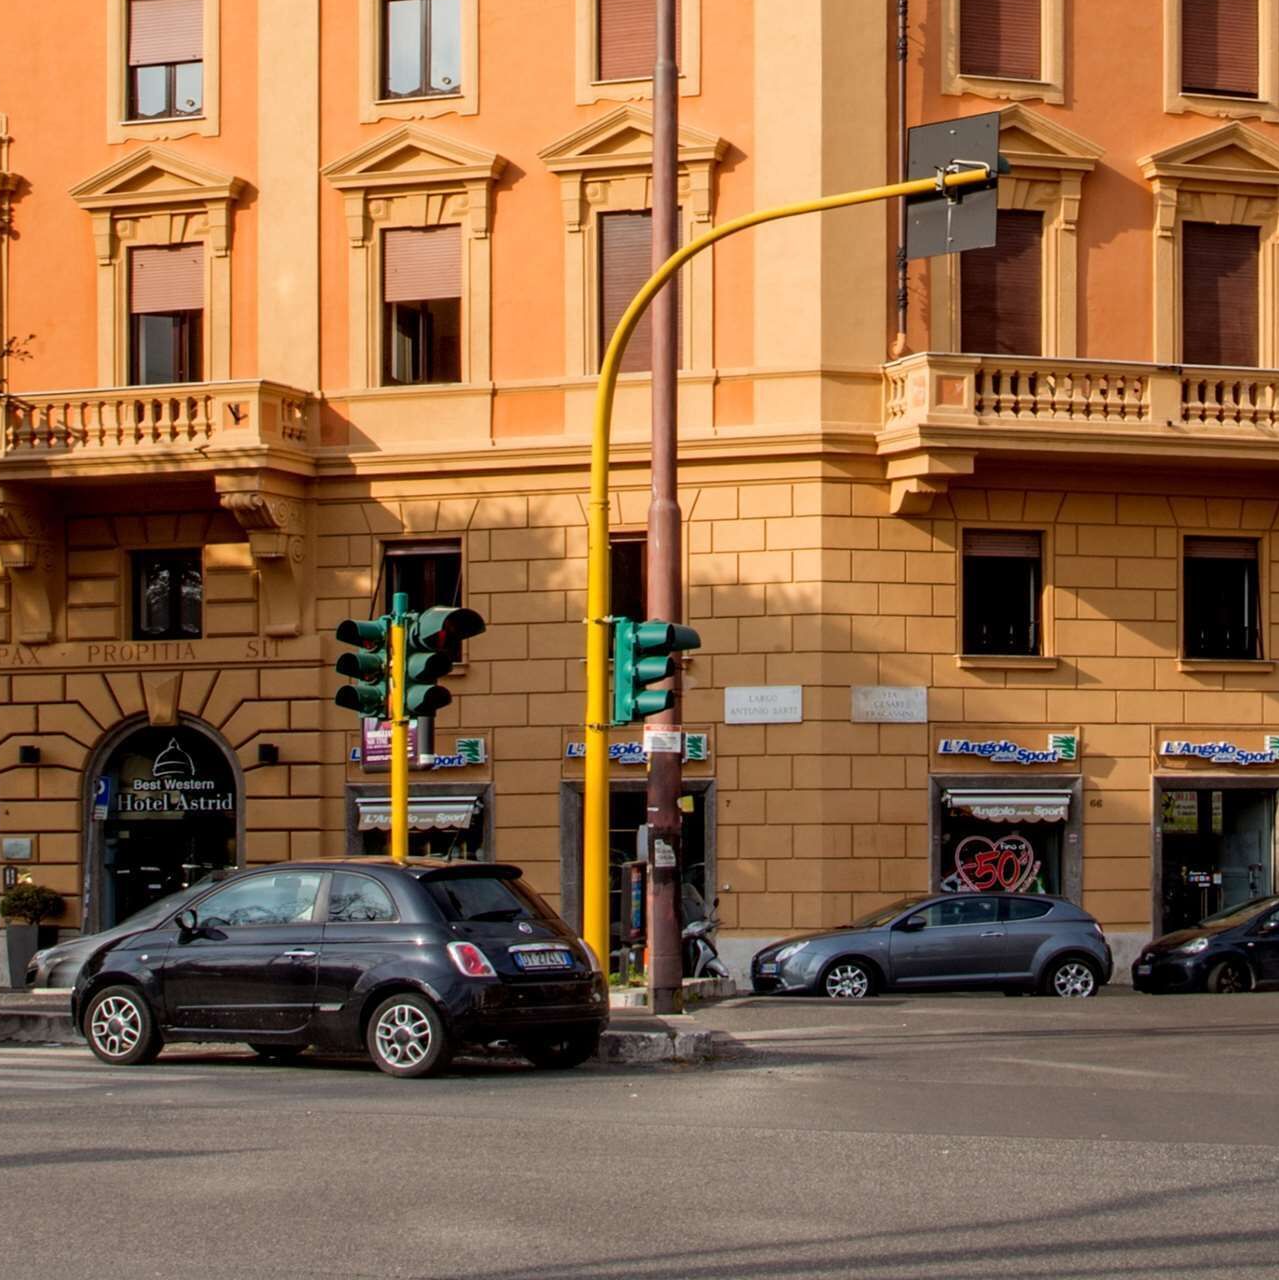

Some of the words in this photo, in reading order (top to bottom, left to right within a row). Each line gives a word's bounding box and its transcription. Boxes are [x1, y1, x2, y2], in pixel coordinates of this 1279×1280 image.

[87, 642, 196, 662] PROPITIA
[245, 640, 284, 658] SIT
[941, 740, 1017, 755] L'Angolo
[1017, 749, 1058, 763] Sport
[1164, 742, 1236, 756] L'Angolo
[1236, 750, 1274, 763] Sport
[432, 753, 465, 768] port
[133, 778, 161, 790] Best
[164, 778, 215, 790] Western
[117, 793, 169, 811] Hotel
[175, 792, 233, 811] Astrid
[435, 812, 466, 826] Sport
[1033, 805, 1065, 818] Sport
